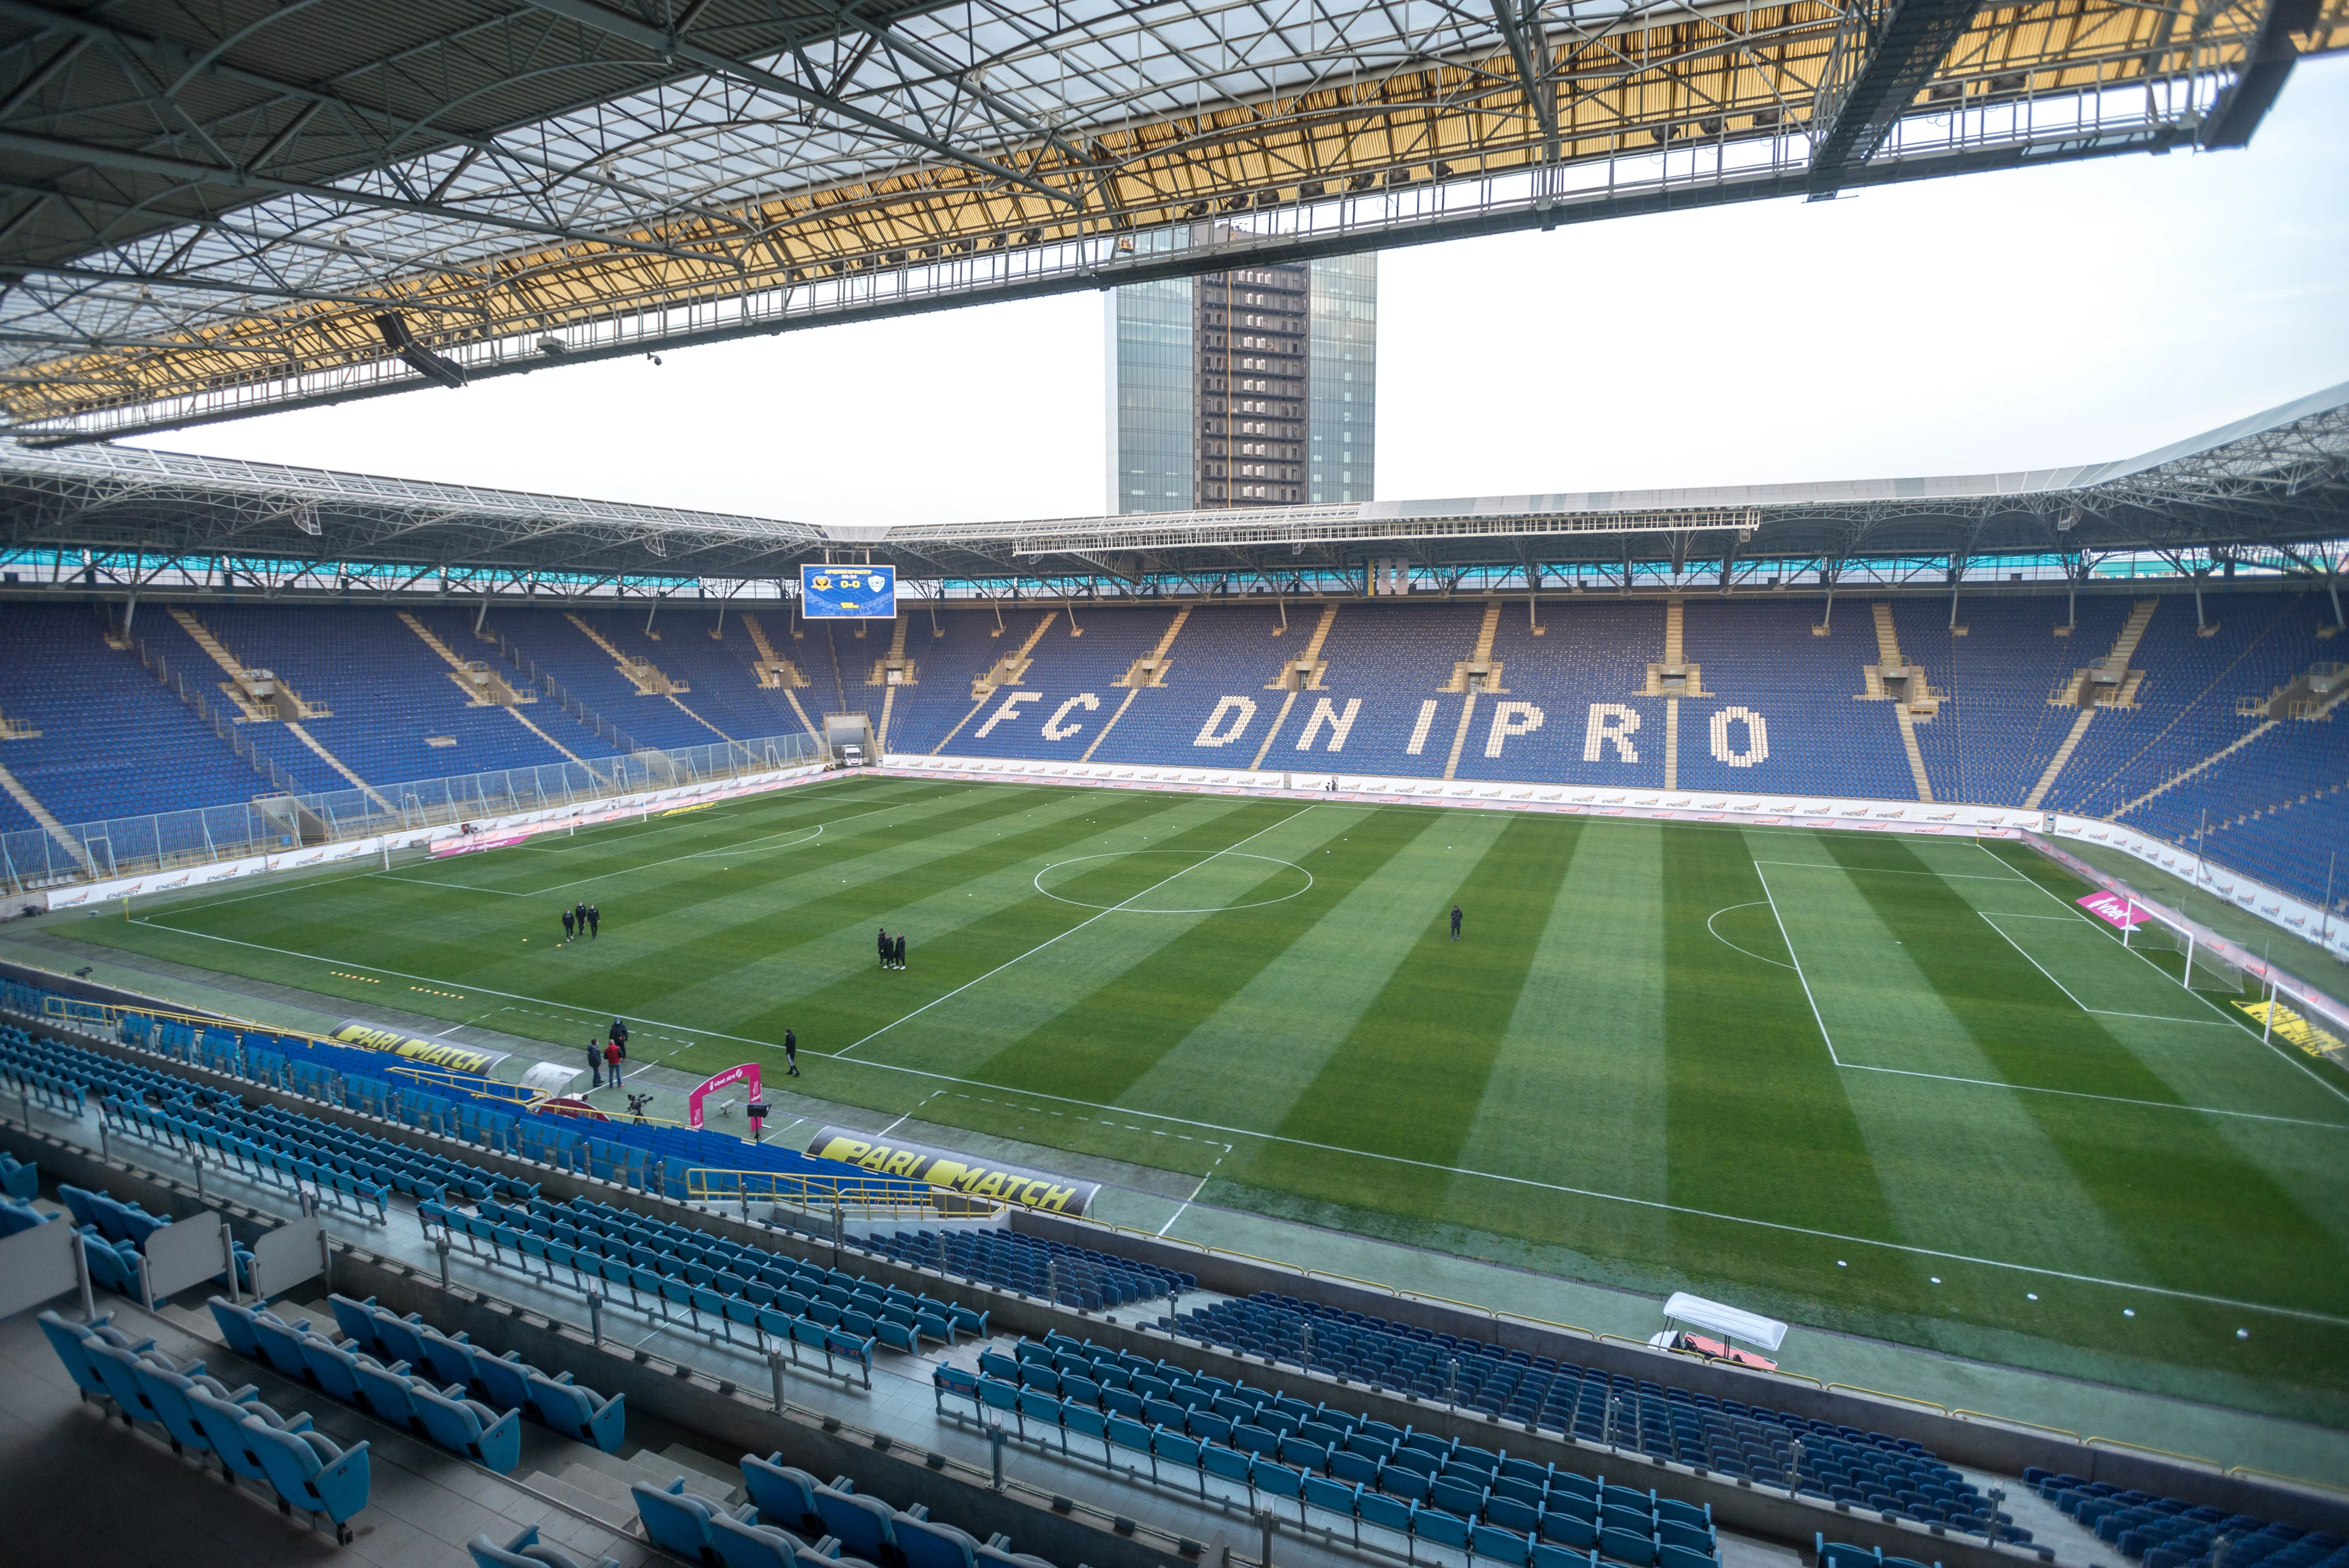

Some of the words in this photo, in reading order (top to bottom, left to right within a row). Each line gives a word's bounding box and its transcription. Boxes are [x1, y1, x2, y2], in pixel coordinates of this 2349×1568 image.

[840, 580, 861, 588] 0-0
[974, 692, 1100, 741] FC
[1194, 696, 1769, 767] DNIPRO
[207, 873, 237, 881] ENERGY
[2180, 868, 2193, 877] ENERGY
[155, 881, 187, 890] ENERGY
[107, 890, 139, 899] ENERGY
[2217, 886, 2232, 895] ENERGY
[2237, 895, 2253, 906] ENERGY
[2261, 906, 2278, 918] ENERGY
[2284, 917, 2303, 929] ENERGY
[336, 1025, 406, 1051] PARI
[395, 1038, 492, 1072] MATCH
[714, 1078, 725, 1087] vbet
[819, 1136, 928, 1175] PARI
[923, 1159, 1077, 1211] MATCH
